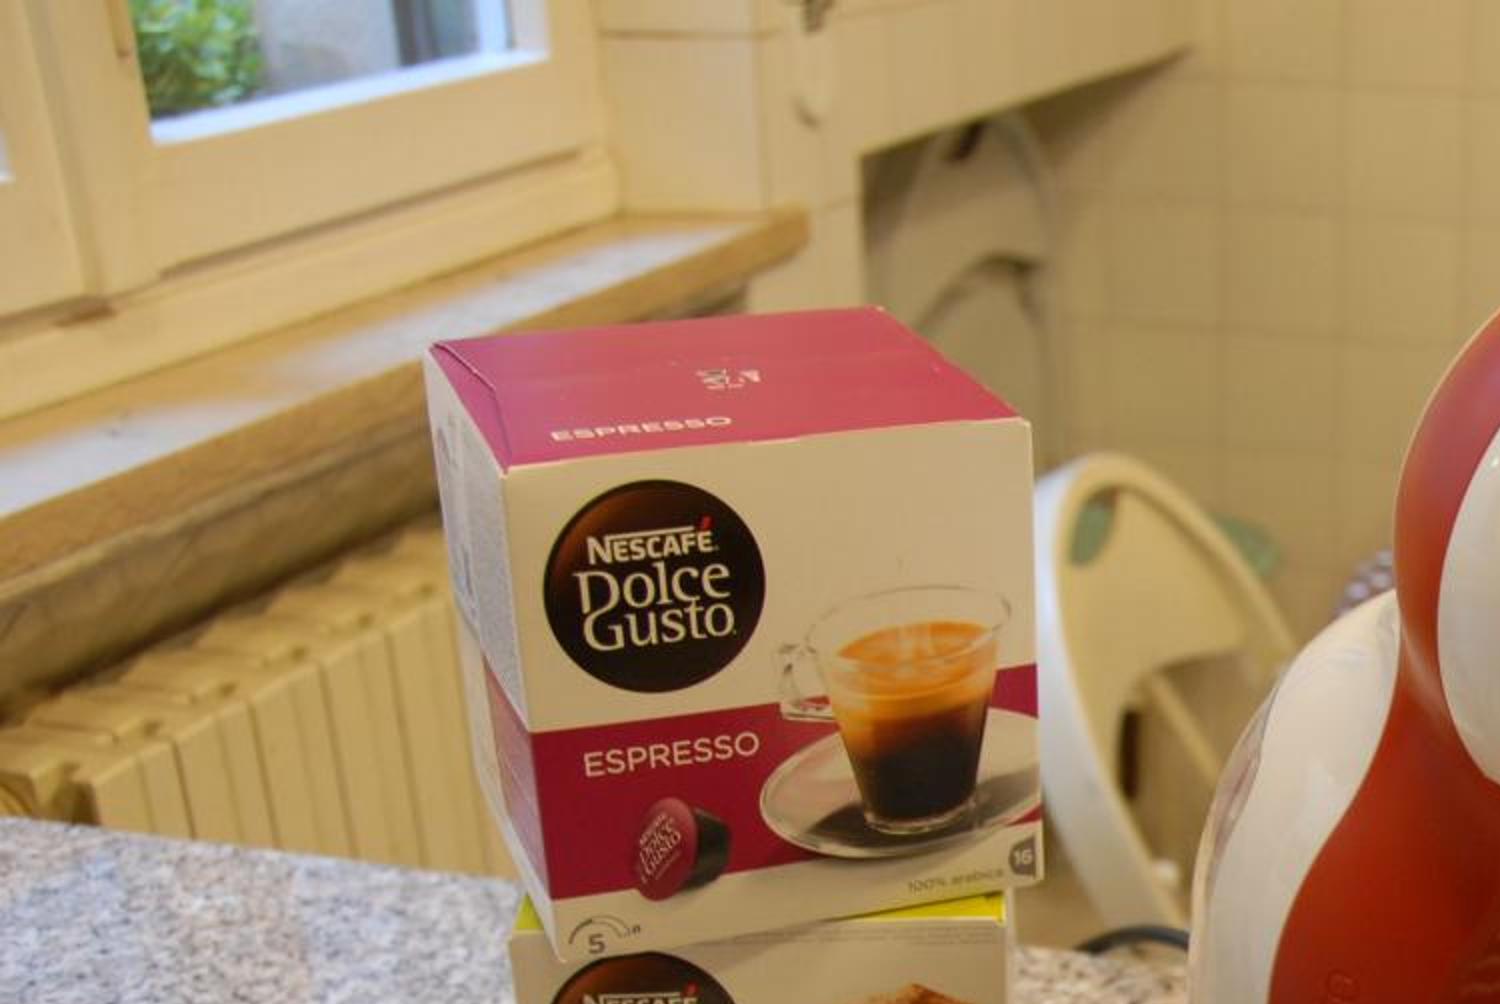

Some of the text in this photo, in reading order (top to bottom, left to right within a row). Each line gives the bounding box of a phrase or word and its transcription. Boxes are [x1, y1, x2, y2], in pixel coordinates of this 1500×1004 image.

[550, 416, 732, 441] ESPRESSO
[586, 516, 714, 565] NESCAFÉ
[572, 561, 731, 615] Dolce
[583, 598, 735, 652] Gusto
[583, 731, 760, 778] ESPRESSO
[588, 932, 606, 956] 5
